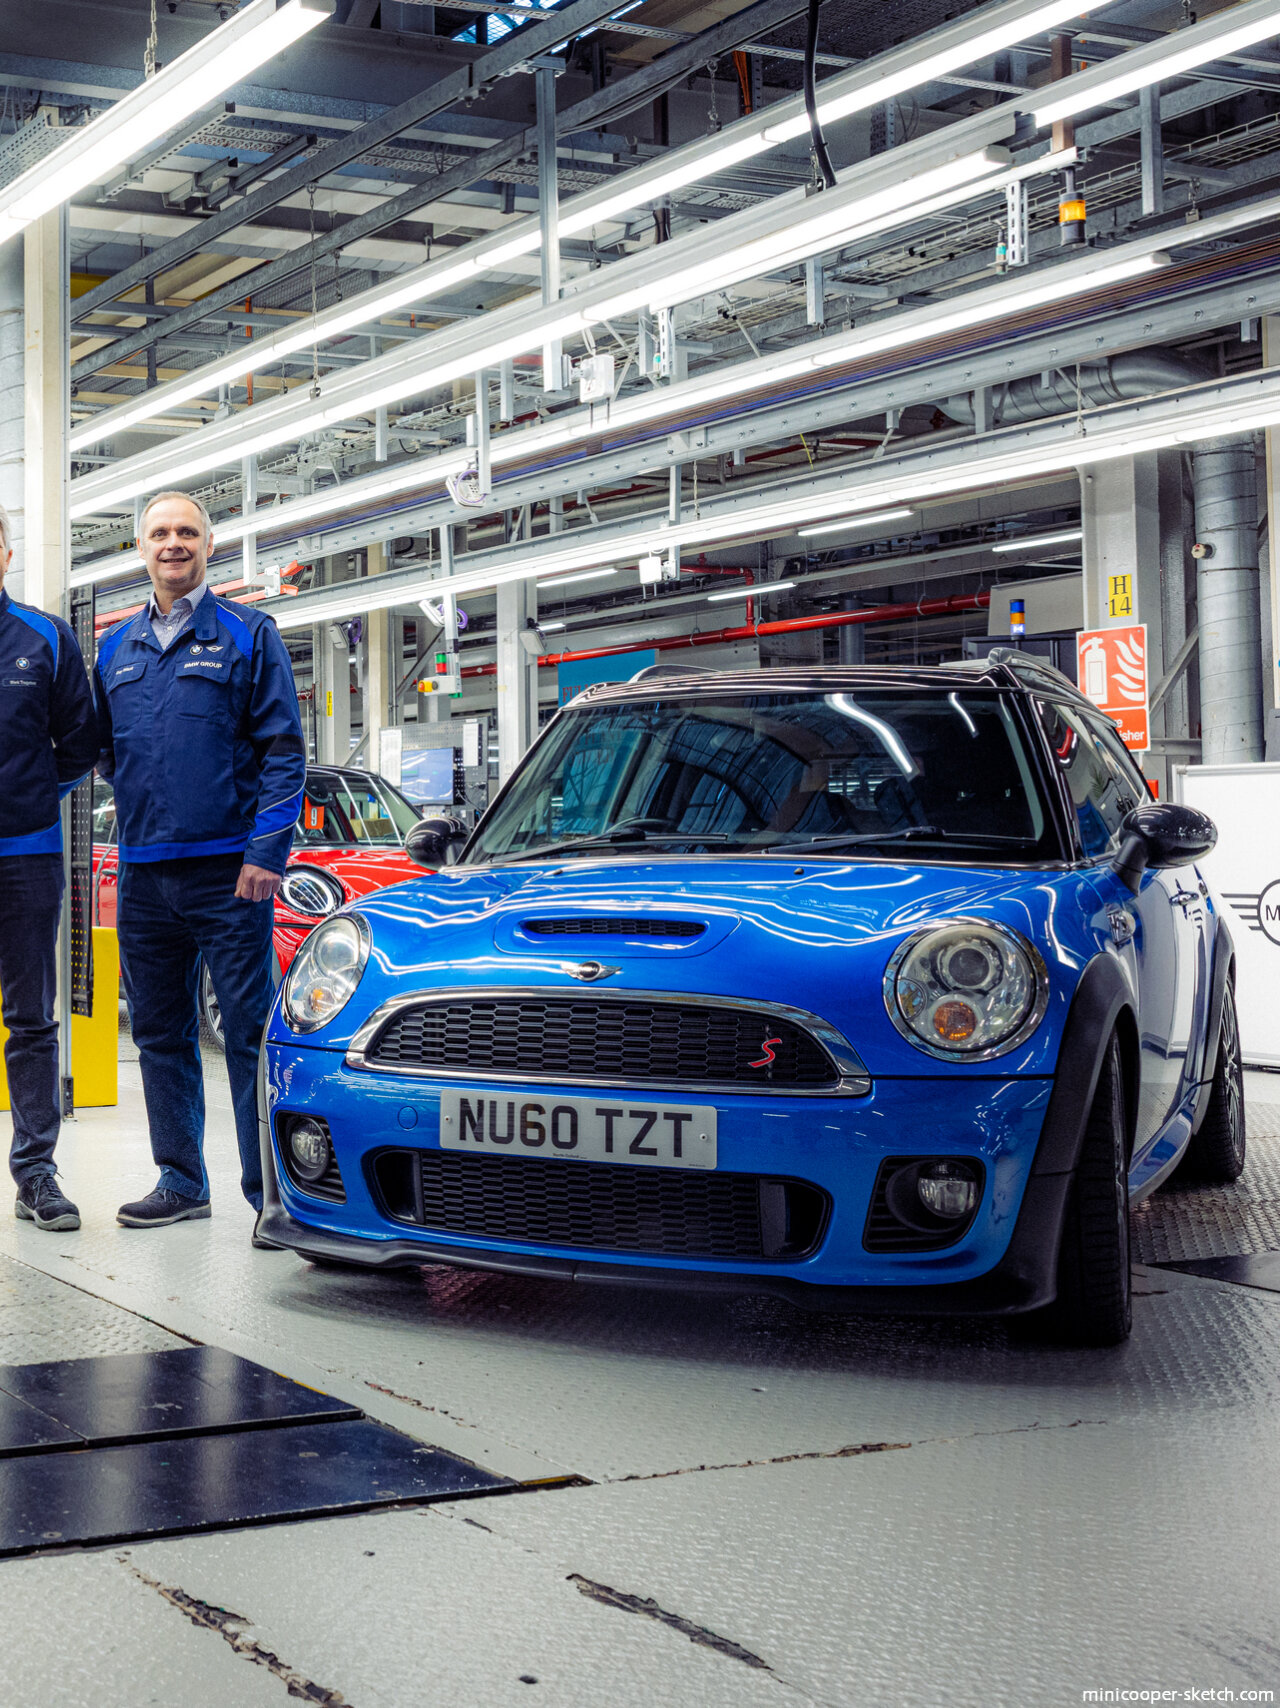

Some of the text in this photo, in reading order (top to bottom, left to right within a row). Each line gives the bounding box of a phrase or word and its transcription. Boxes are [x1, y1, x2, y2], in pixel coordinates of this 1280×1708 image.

[1112, 575, 1128, 595] H
[1109, 596, 1132, 616] 14
[200, 661, 223, 669] GROUP
[311, 807, 318, 827] 9
[748, 1037, 783, 1068] S
[459, 1098, 693, 1158] NU60 TZT
